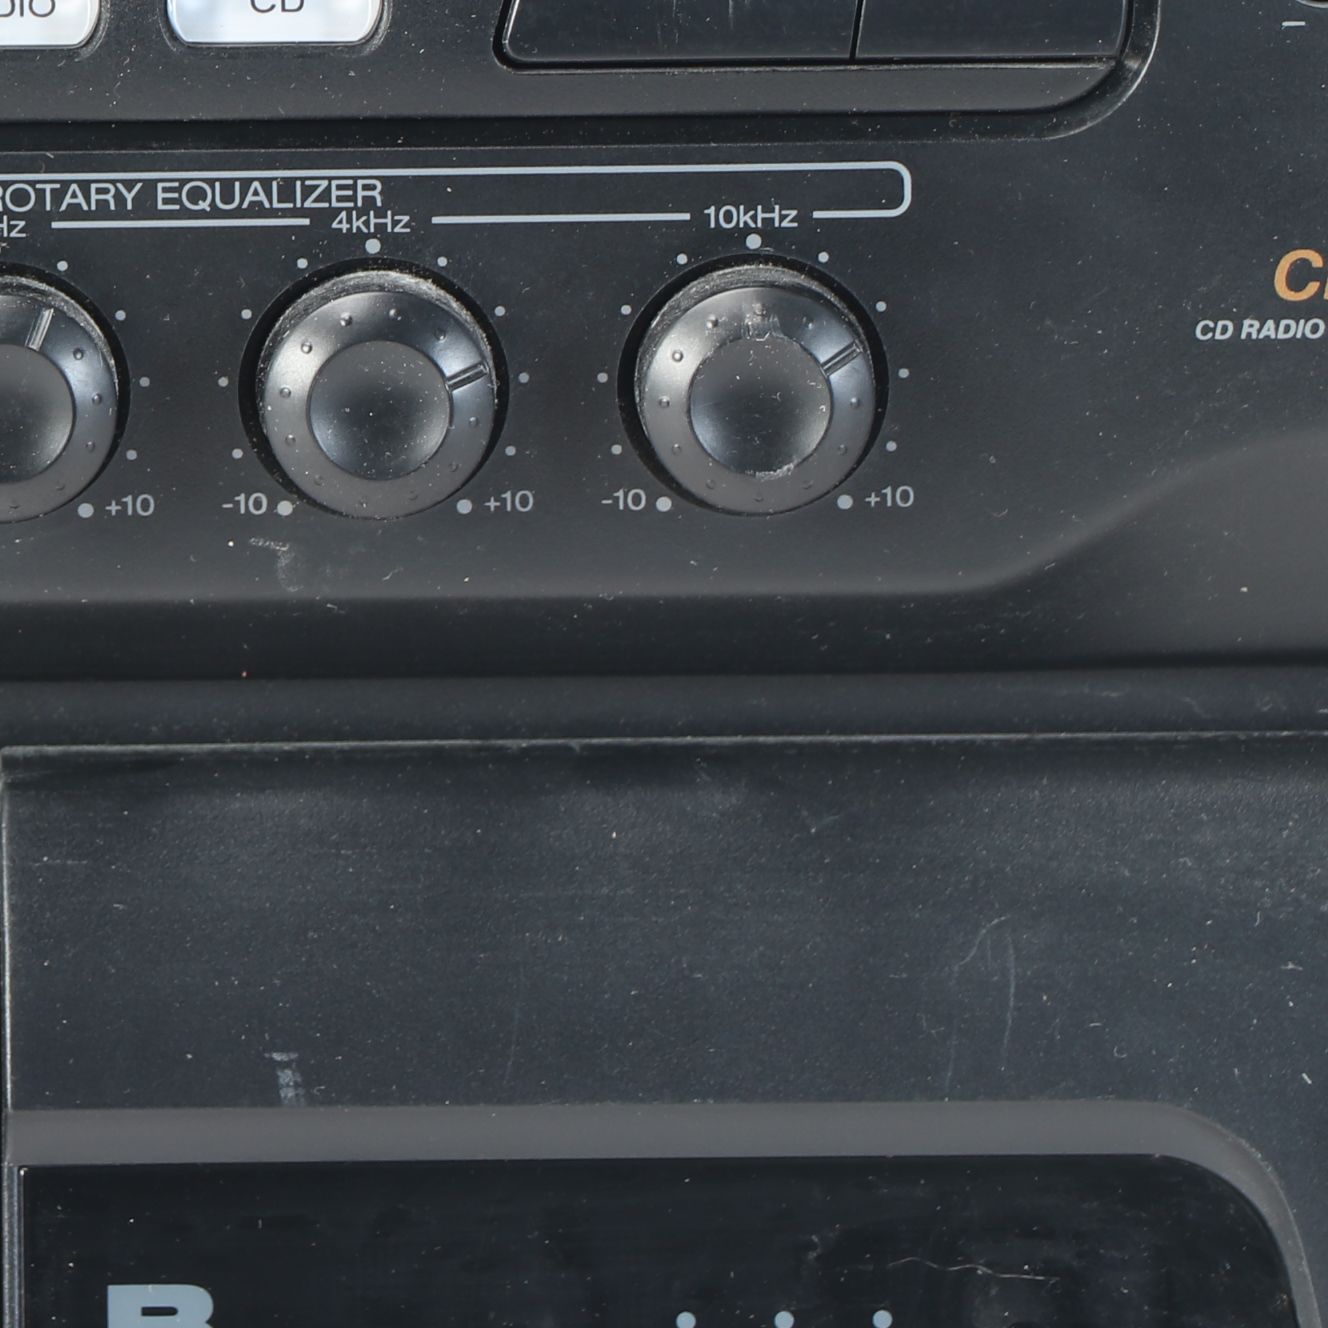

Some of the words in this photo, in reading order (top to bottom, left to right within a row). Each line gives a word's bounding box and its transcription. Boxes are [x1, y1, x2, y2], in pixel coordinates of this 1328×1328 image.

[157, 180, 381, 211] EQUALIZER
[332, 210, 410, 233] 4kHz
[704, 205, 798, 228] 10kHz
[1274, 250, 1328, 301] C
[1196, 320, 1233, 340] CD
[1241, 319, 1325, 339] RADIO
[106, 494, 154, 516] +10
[223, 493, 267, 514] -10
[485, 491, 533, 511] +10
[602, 489, 646, 510] -10
[866, 486, 914, 507] +10
